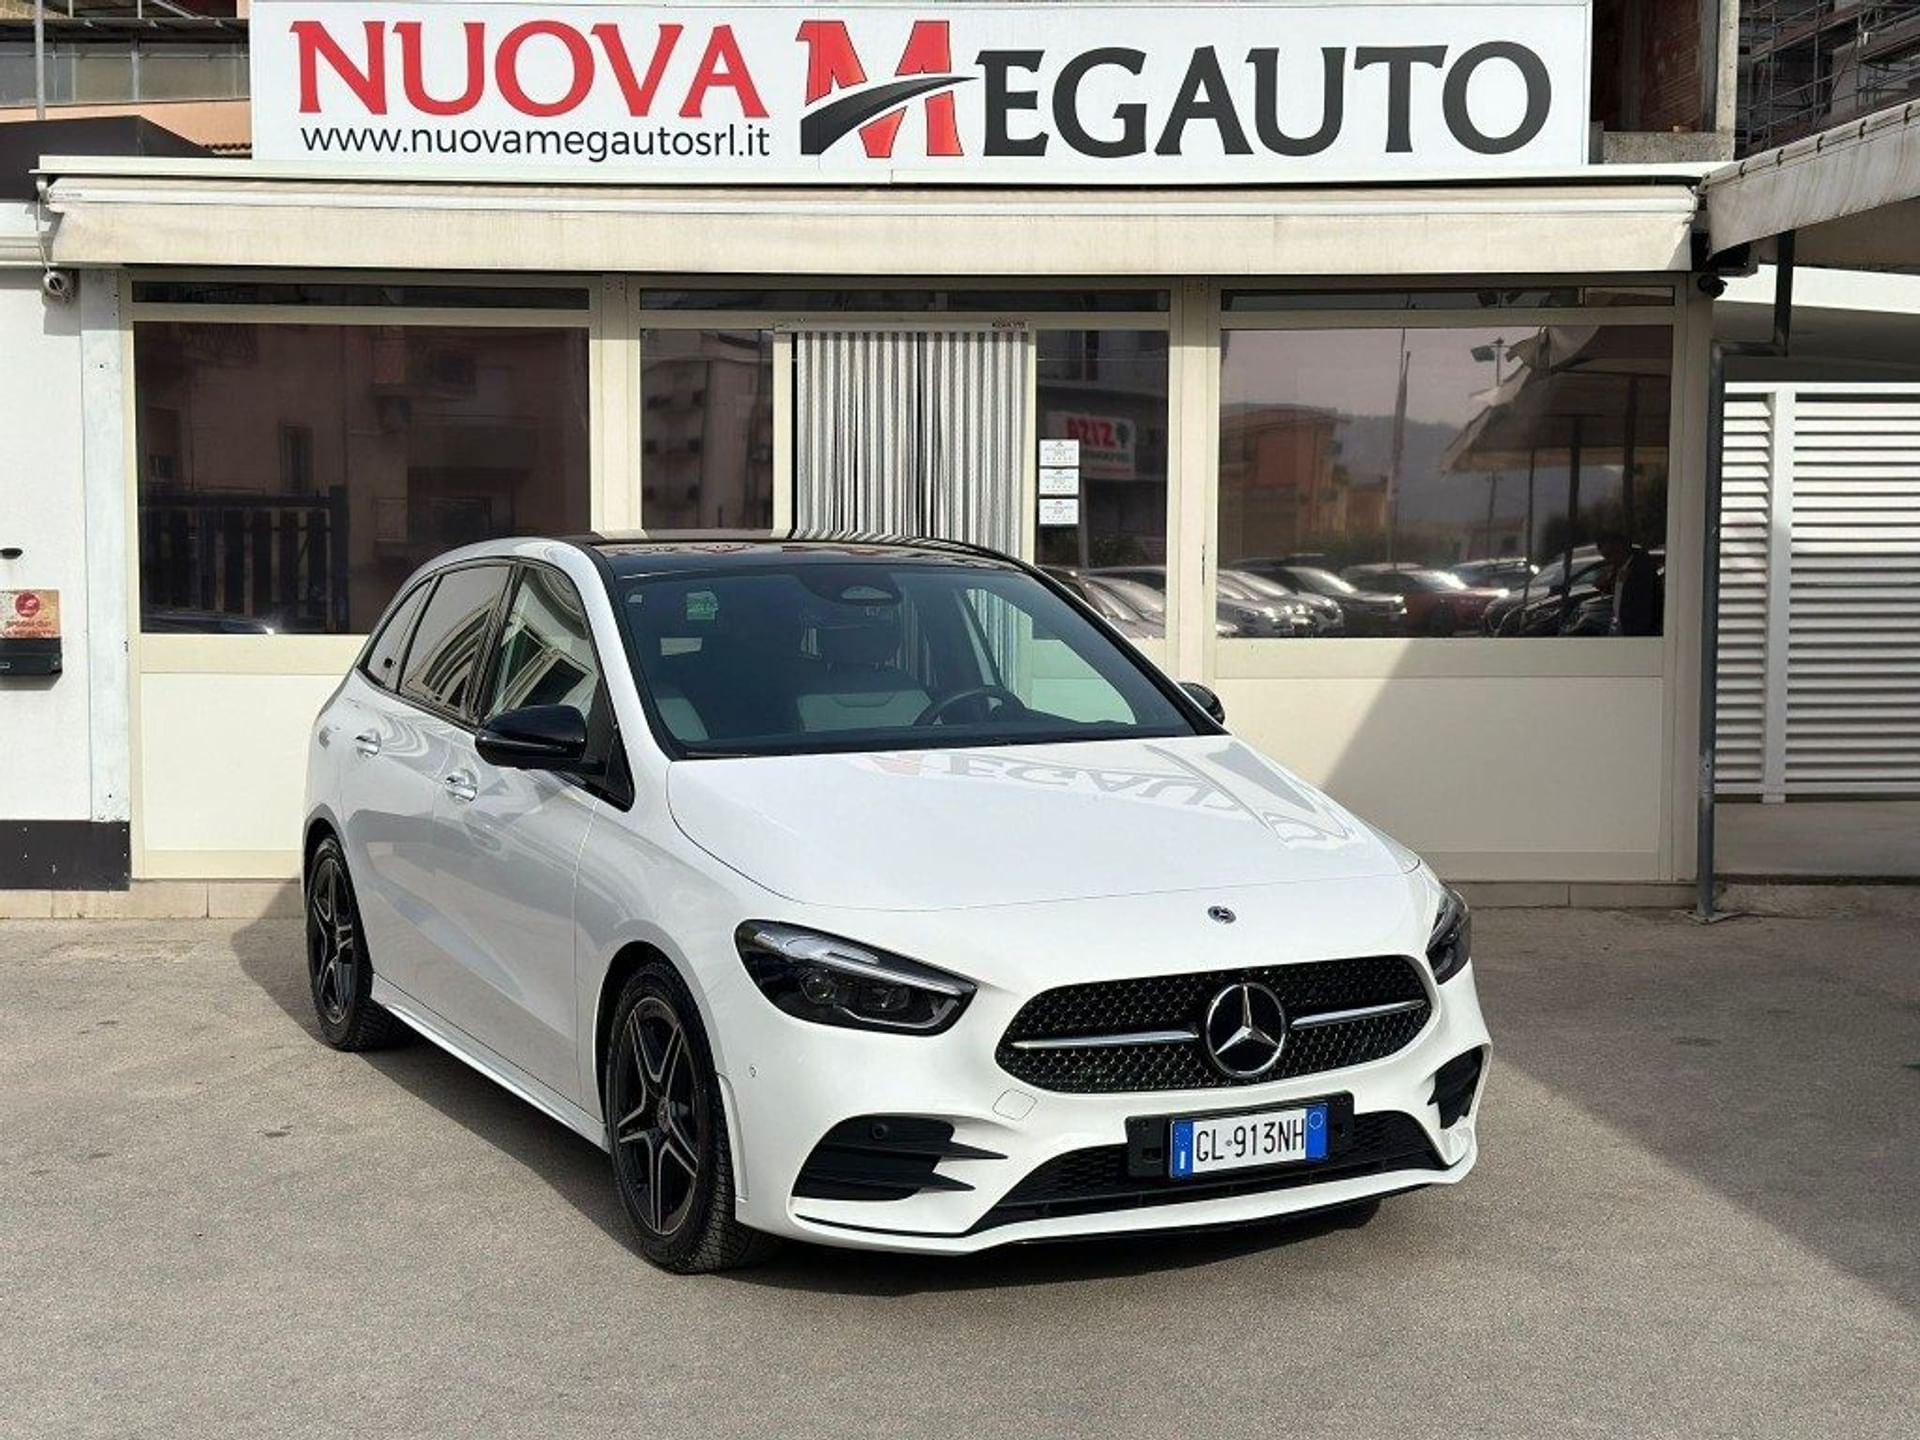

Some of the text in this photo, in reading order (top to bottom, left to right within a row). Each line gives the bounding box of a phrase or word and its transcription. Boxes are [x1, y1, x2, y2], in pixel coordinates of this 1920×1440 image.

[291, 20, 1552, 158] NUOVA MEGAUTO
[300, 123, 770, 162] www.nuovamegautosrl.it
